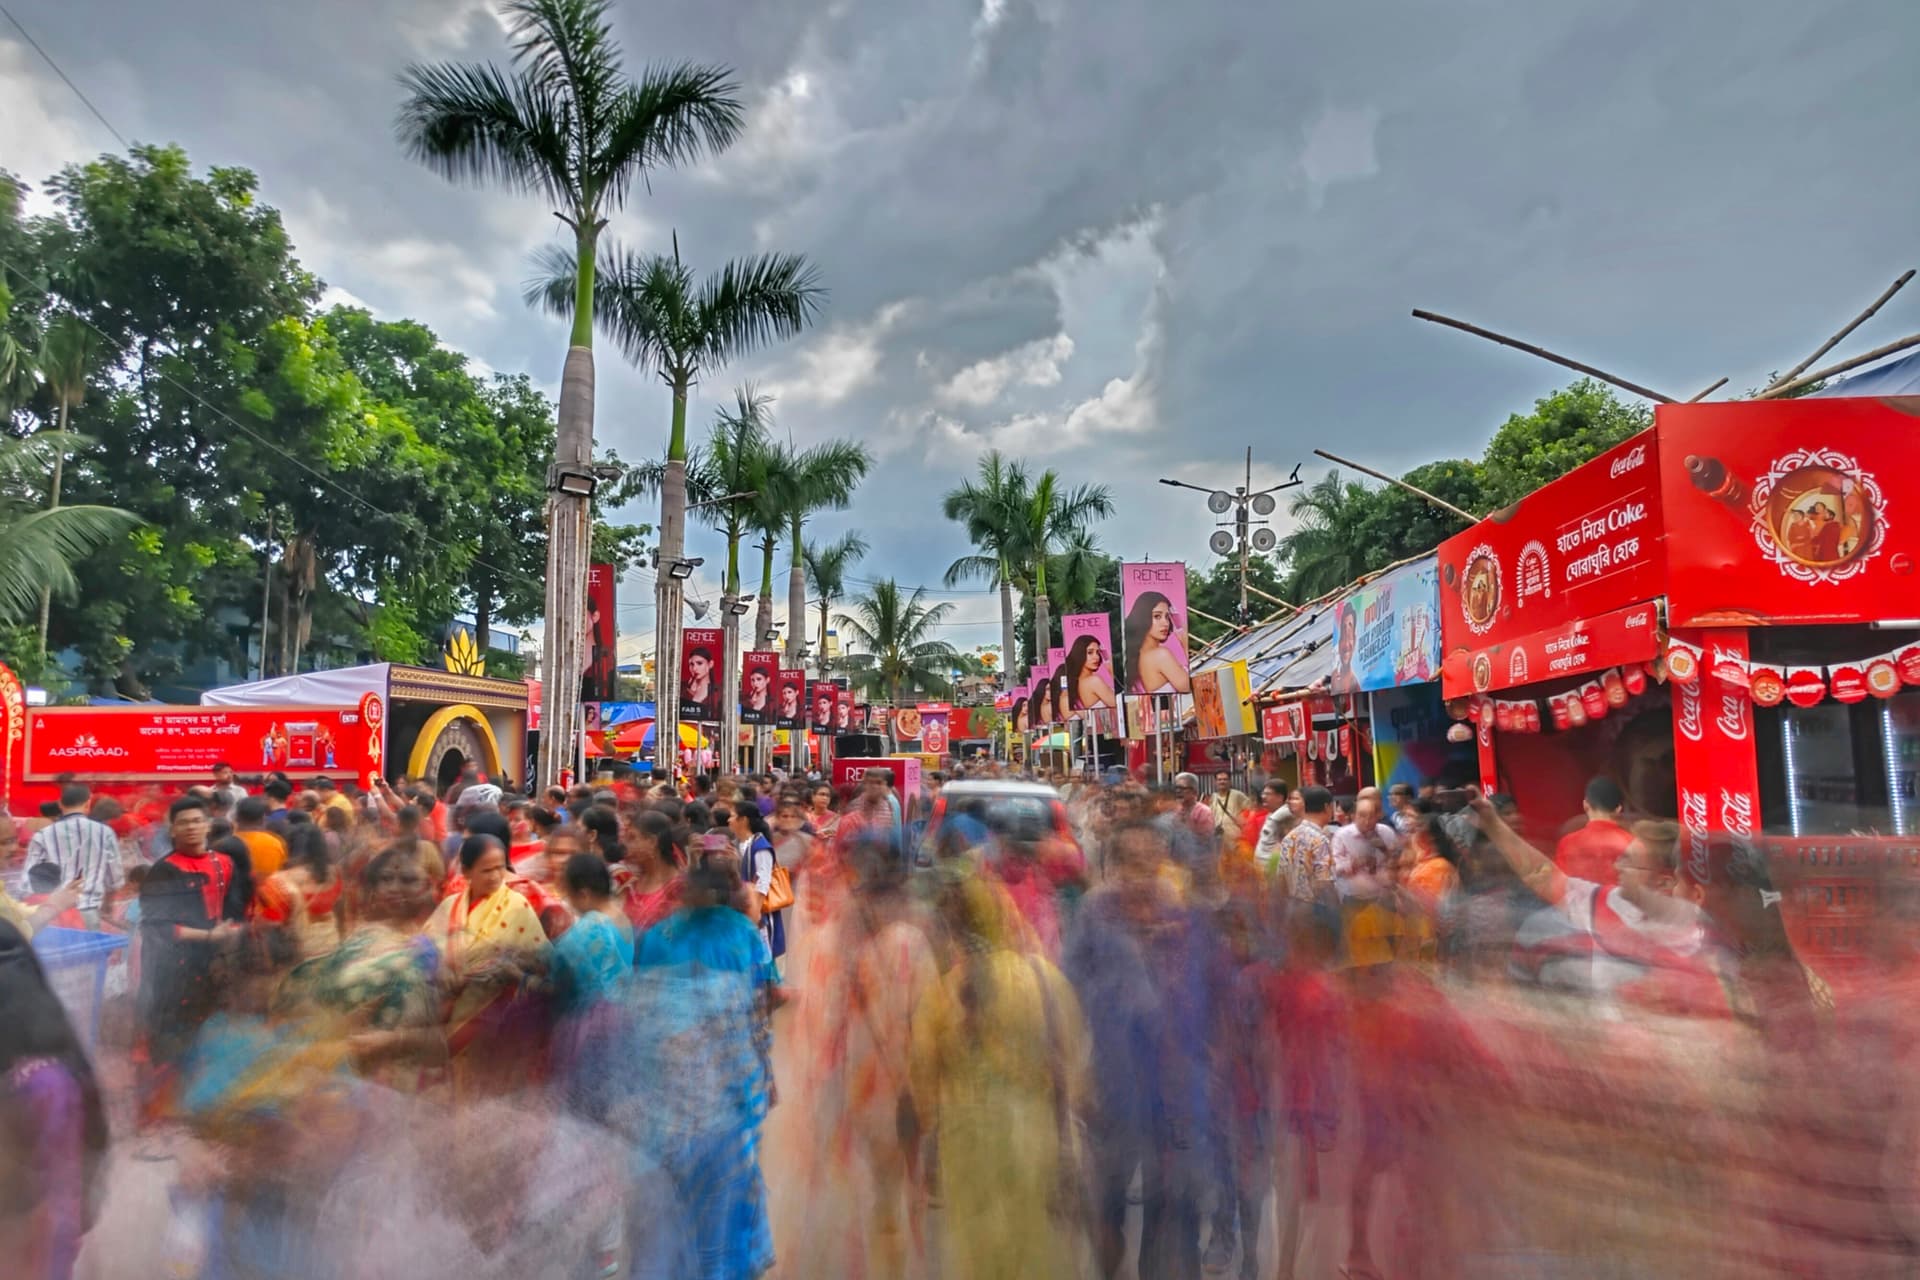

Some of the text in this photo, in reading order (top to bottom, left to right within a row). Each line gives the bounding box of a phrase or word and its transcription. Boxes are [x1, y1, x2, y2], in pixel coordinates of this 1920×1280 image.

[1610, 444, 1646, 479] Coca-Cola
[1608, 502, 1645, 532] Coke
[1133, 568, 1173, 582] RENEE
[1071, 616, 1101, 628] RENEE
[686, 631, 716, 642] RENEE
[749, 654, 772, 662] RENEE
[48, 747, 124, 758] AASHIRVAAD
